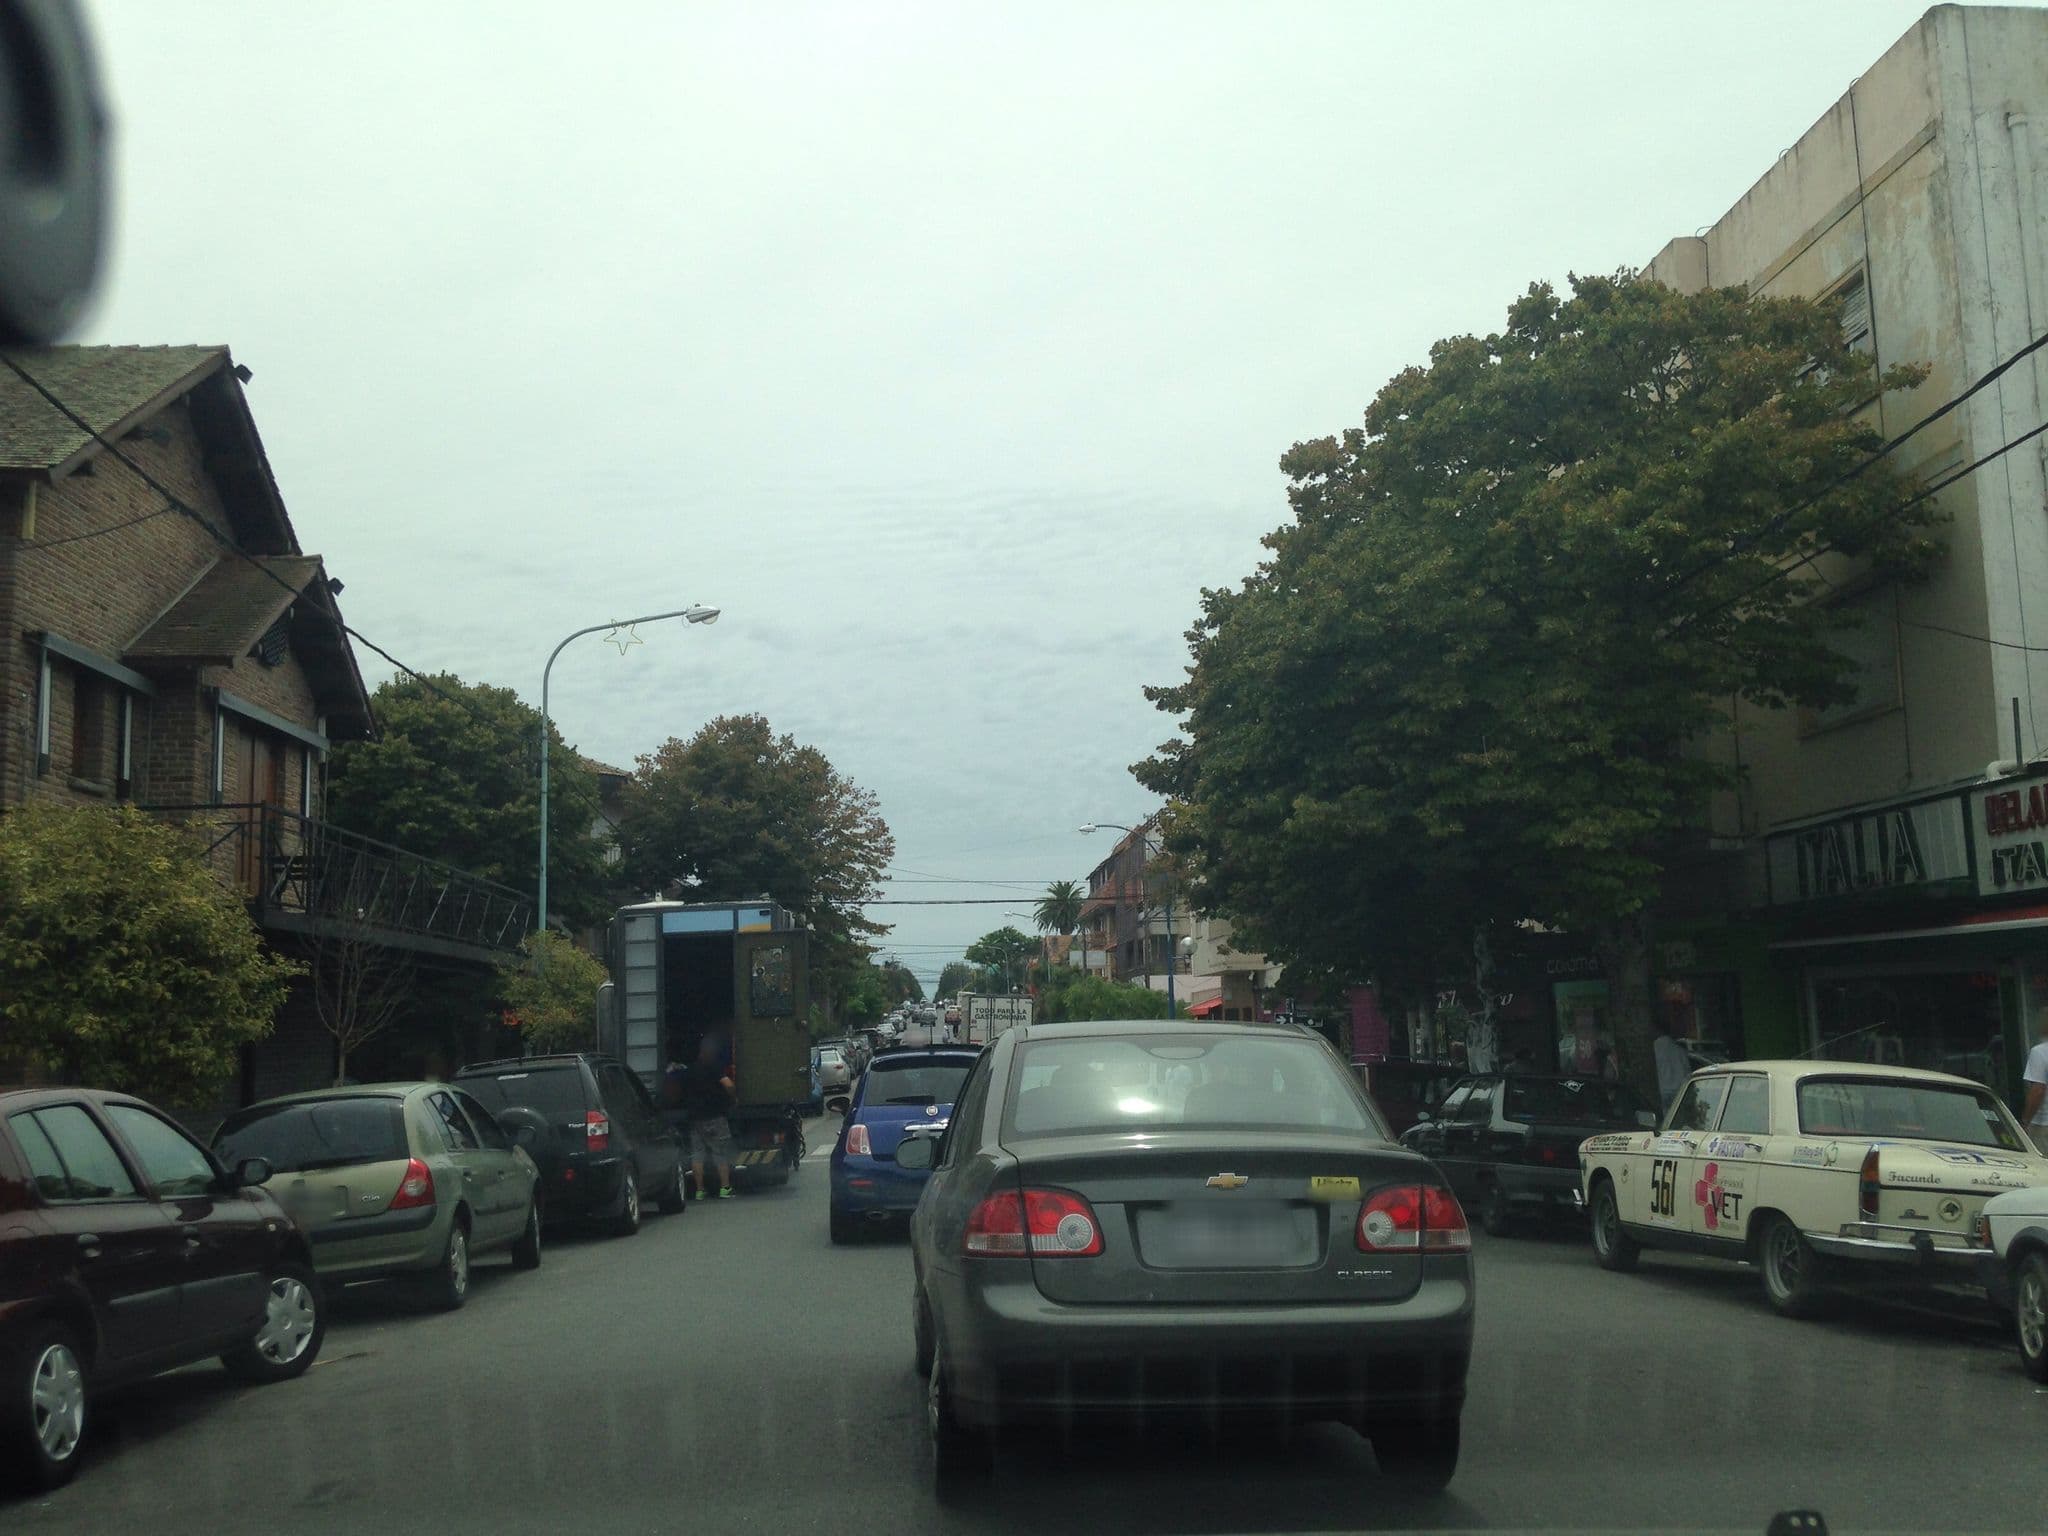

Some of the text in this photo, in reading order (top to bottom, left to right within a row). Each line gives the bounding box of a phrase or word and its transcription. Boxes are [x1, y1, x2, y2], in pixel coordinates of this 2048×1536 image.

[1985, 784, 2048, 836] HELA
[1991, 842, 2048, 886] ITA
[1651, 1160, 1677, 1216] 561
[1888, 1171, 1941, 1185] Facundo
[1711, 1190, 1742, 1220] VET
